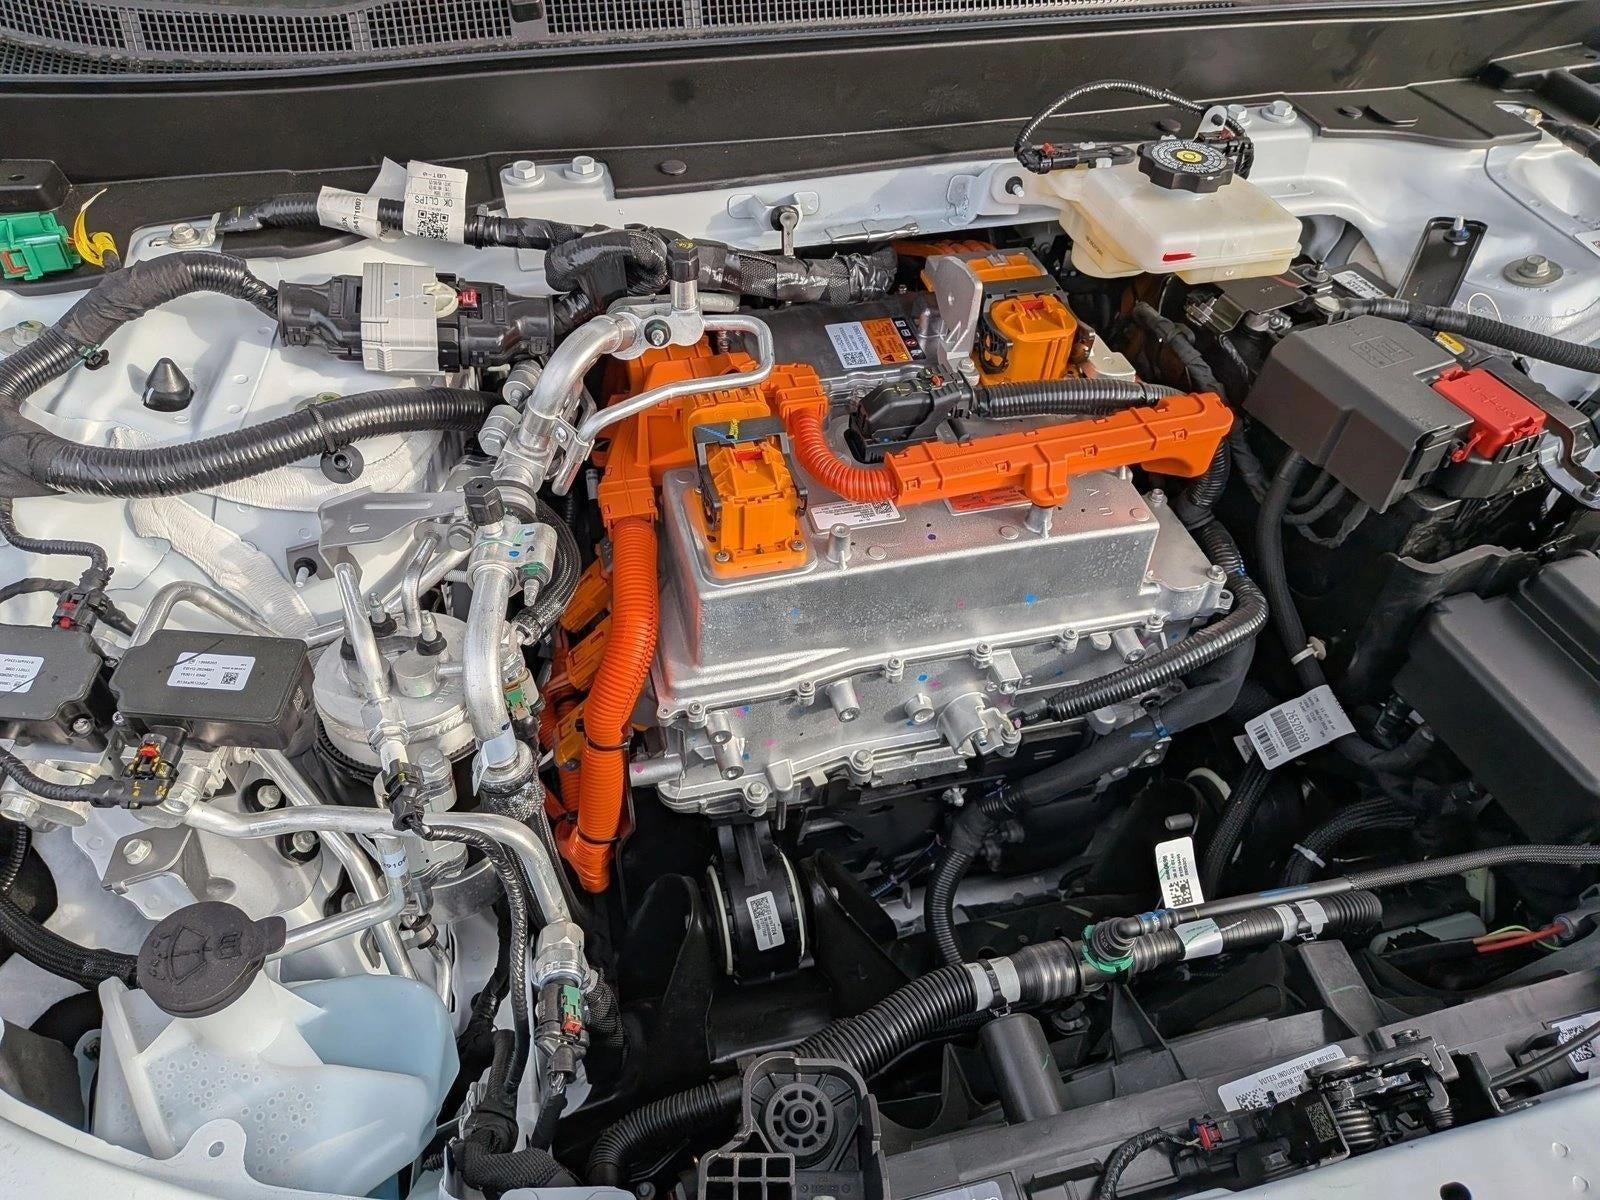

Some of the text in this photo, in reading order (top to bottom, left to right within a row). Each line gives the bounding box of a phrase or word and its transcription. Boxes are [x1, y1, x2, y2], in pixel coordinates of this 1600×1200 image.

[414, 195, 453, 208] OK CLIPS
[1277, 1061, 1309, 1080] INDUSTRIES
[1309, 1059, 1316, 1067] DE
[1317, 1052, 1338, 1065] MEXICO
